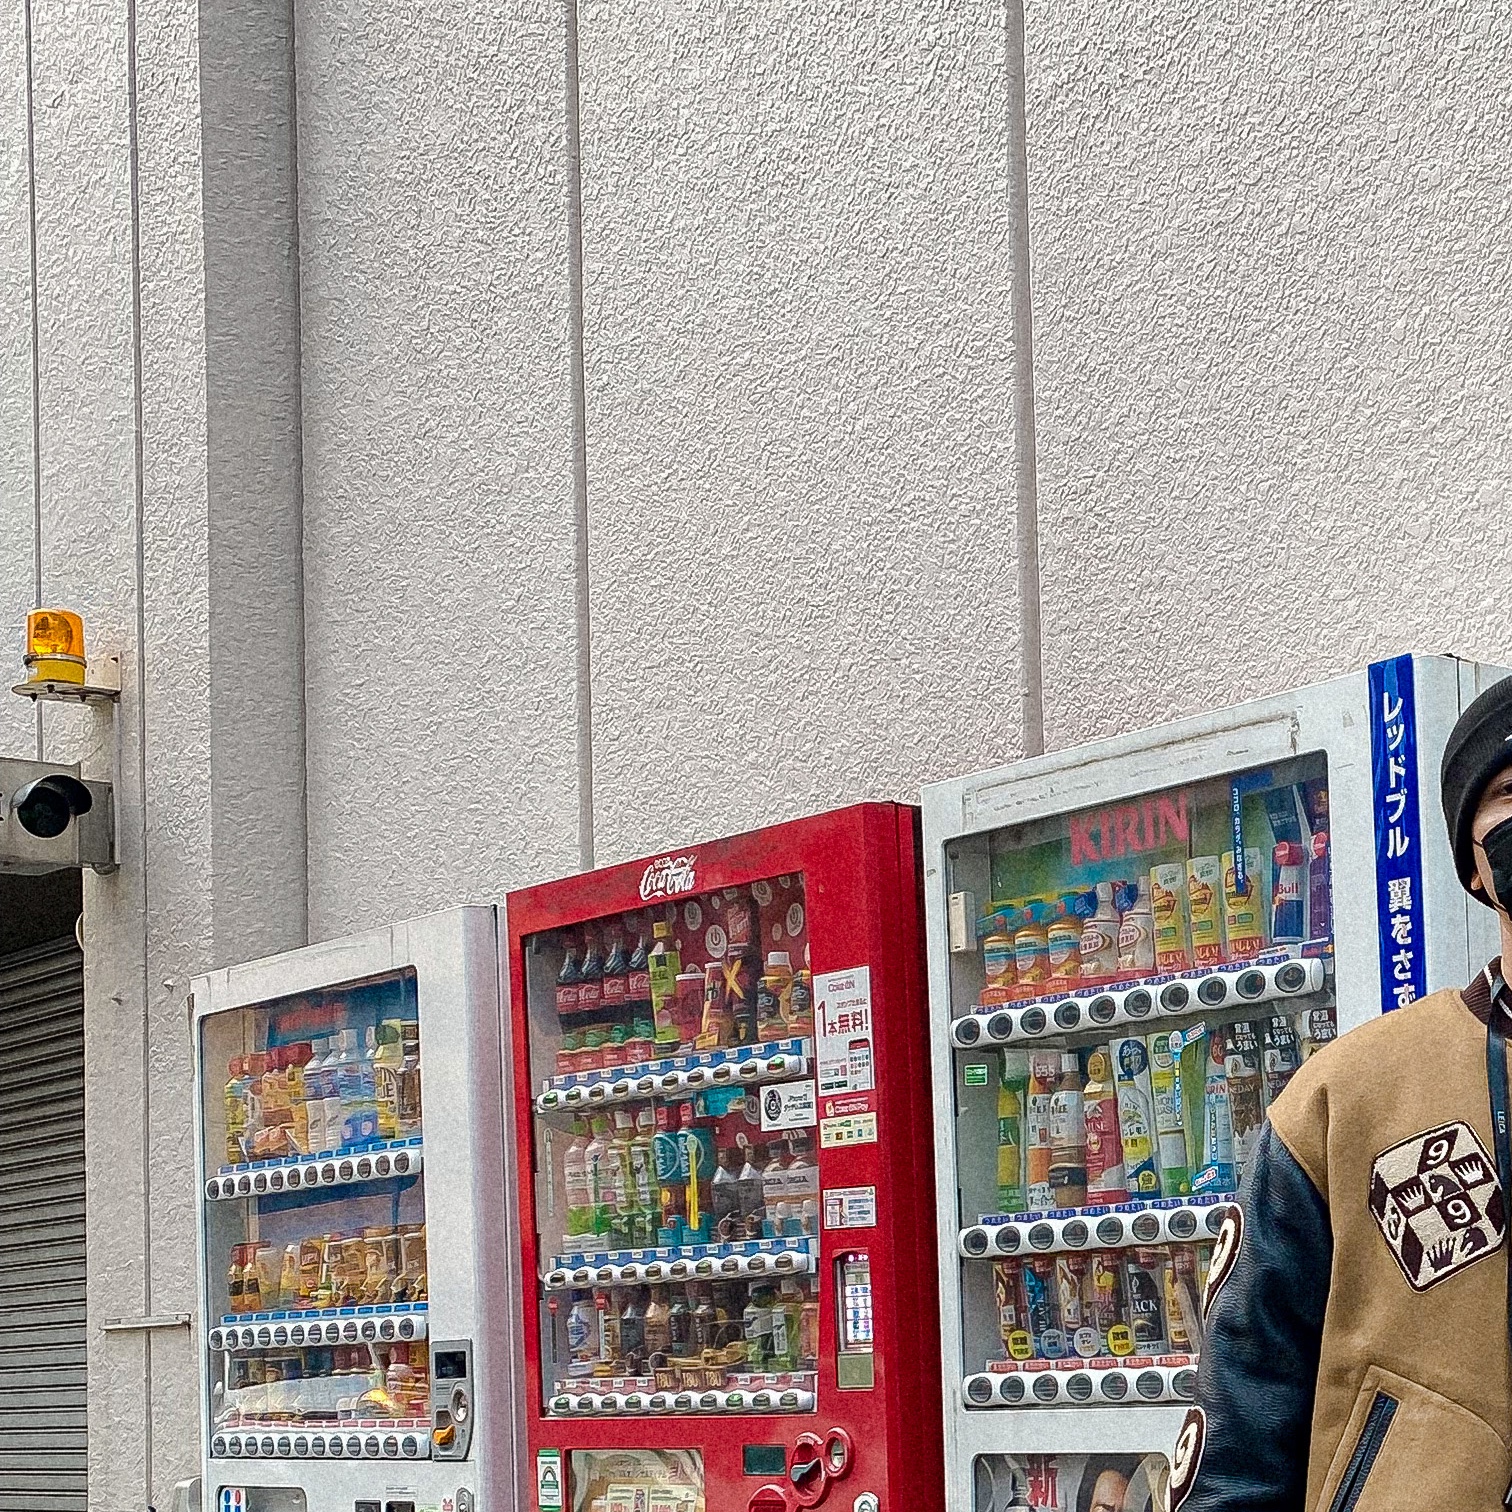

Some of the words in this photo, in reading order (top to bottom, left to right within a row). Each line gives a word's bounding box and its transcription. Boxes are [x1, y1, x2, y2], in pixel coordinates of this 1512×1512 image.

[1382, 692, 1410, 859] レッドブル
[1069, 794, 1189, 866] KIRIN
[1496, 1110, 1506, 1134] LEICA
[1425, 1139, 1450, 1166] 9
[1445, 1198, 1472, 1223] 9
